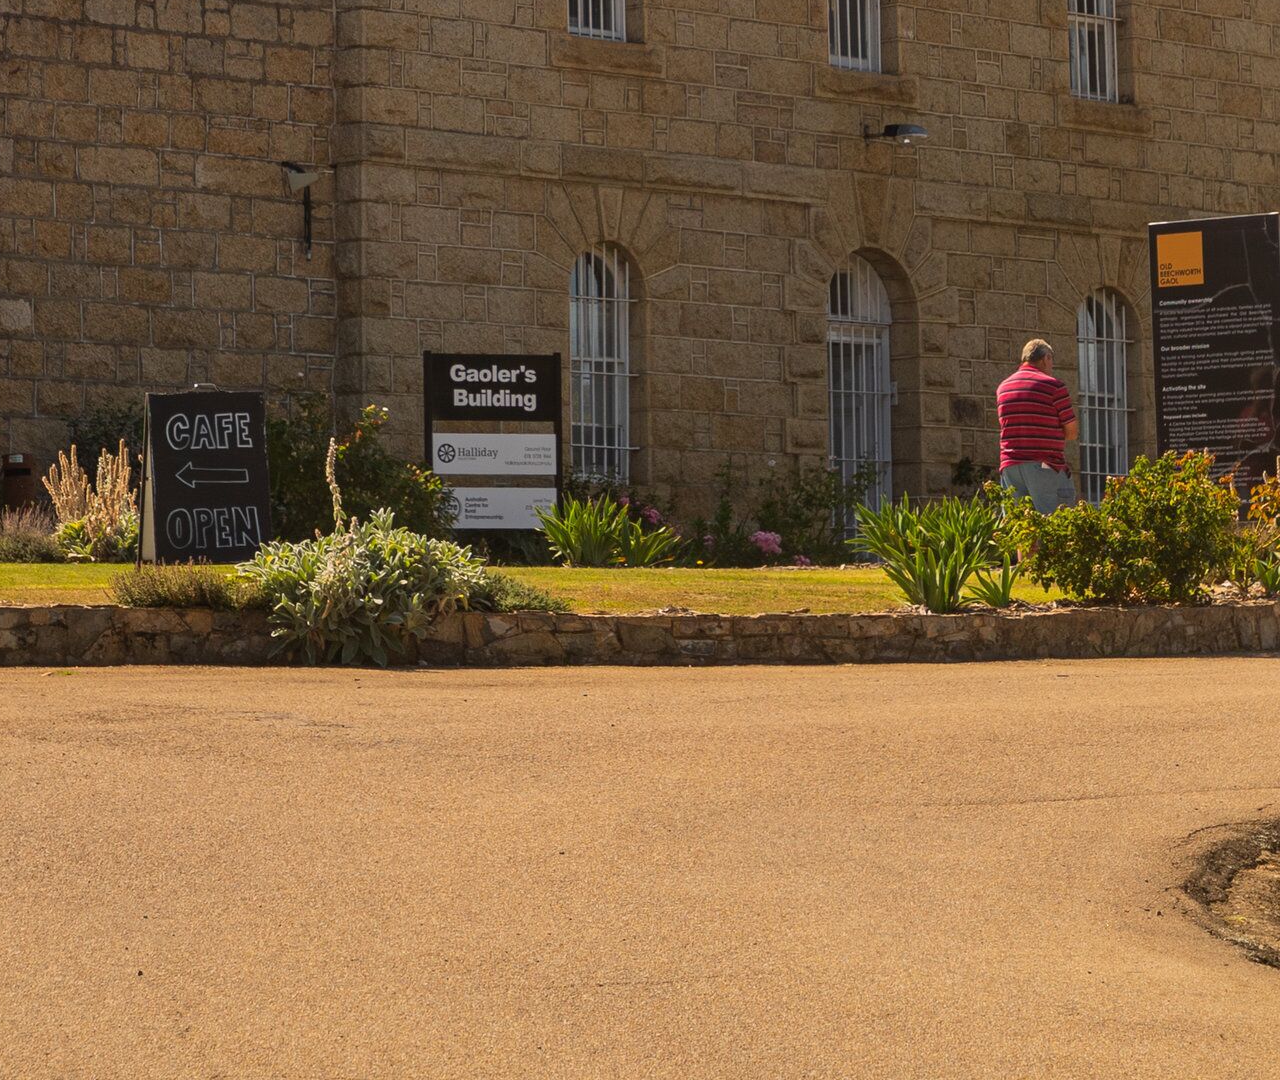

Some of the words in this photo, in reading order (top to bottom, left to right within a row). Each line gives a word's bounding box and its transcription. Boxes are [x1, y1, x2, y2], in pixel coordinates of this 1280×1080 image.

[1160, 268, 1202, 277] BEECHWORTH
[1159, 298, 1186, 306] Community
[449, 364, 537, 383] Gaoler's
[453, 389, 537, 412] Building
[166, 413, 253, 450] CAFE
[457, 447, 498, 460] Halliday
[166, 506, 261, 549] OPEN
